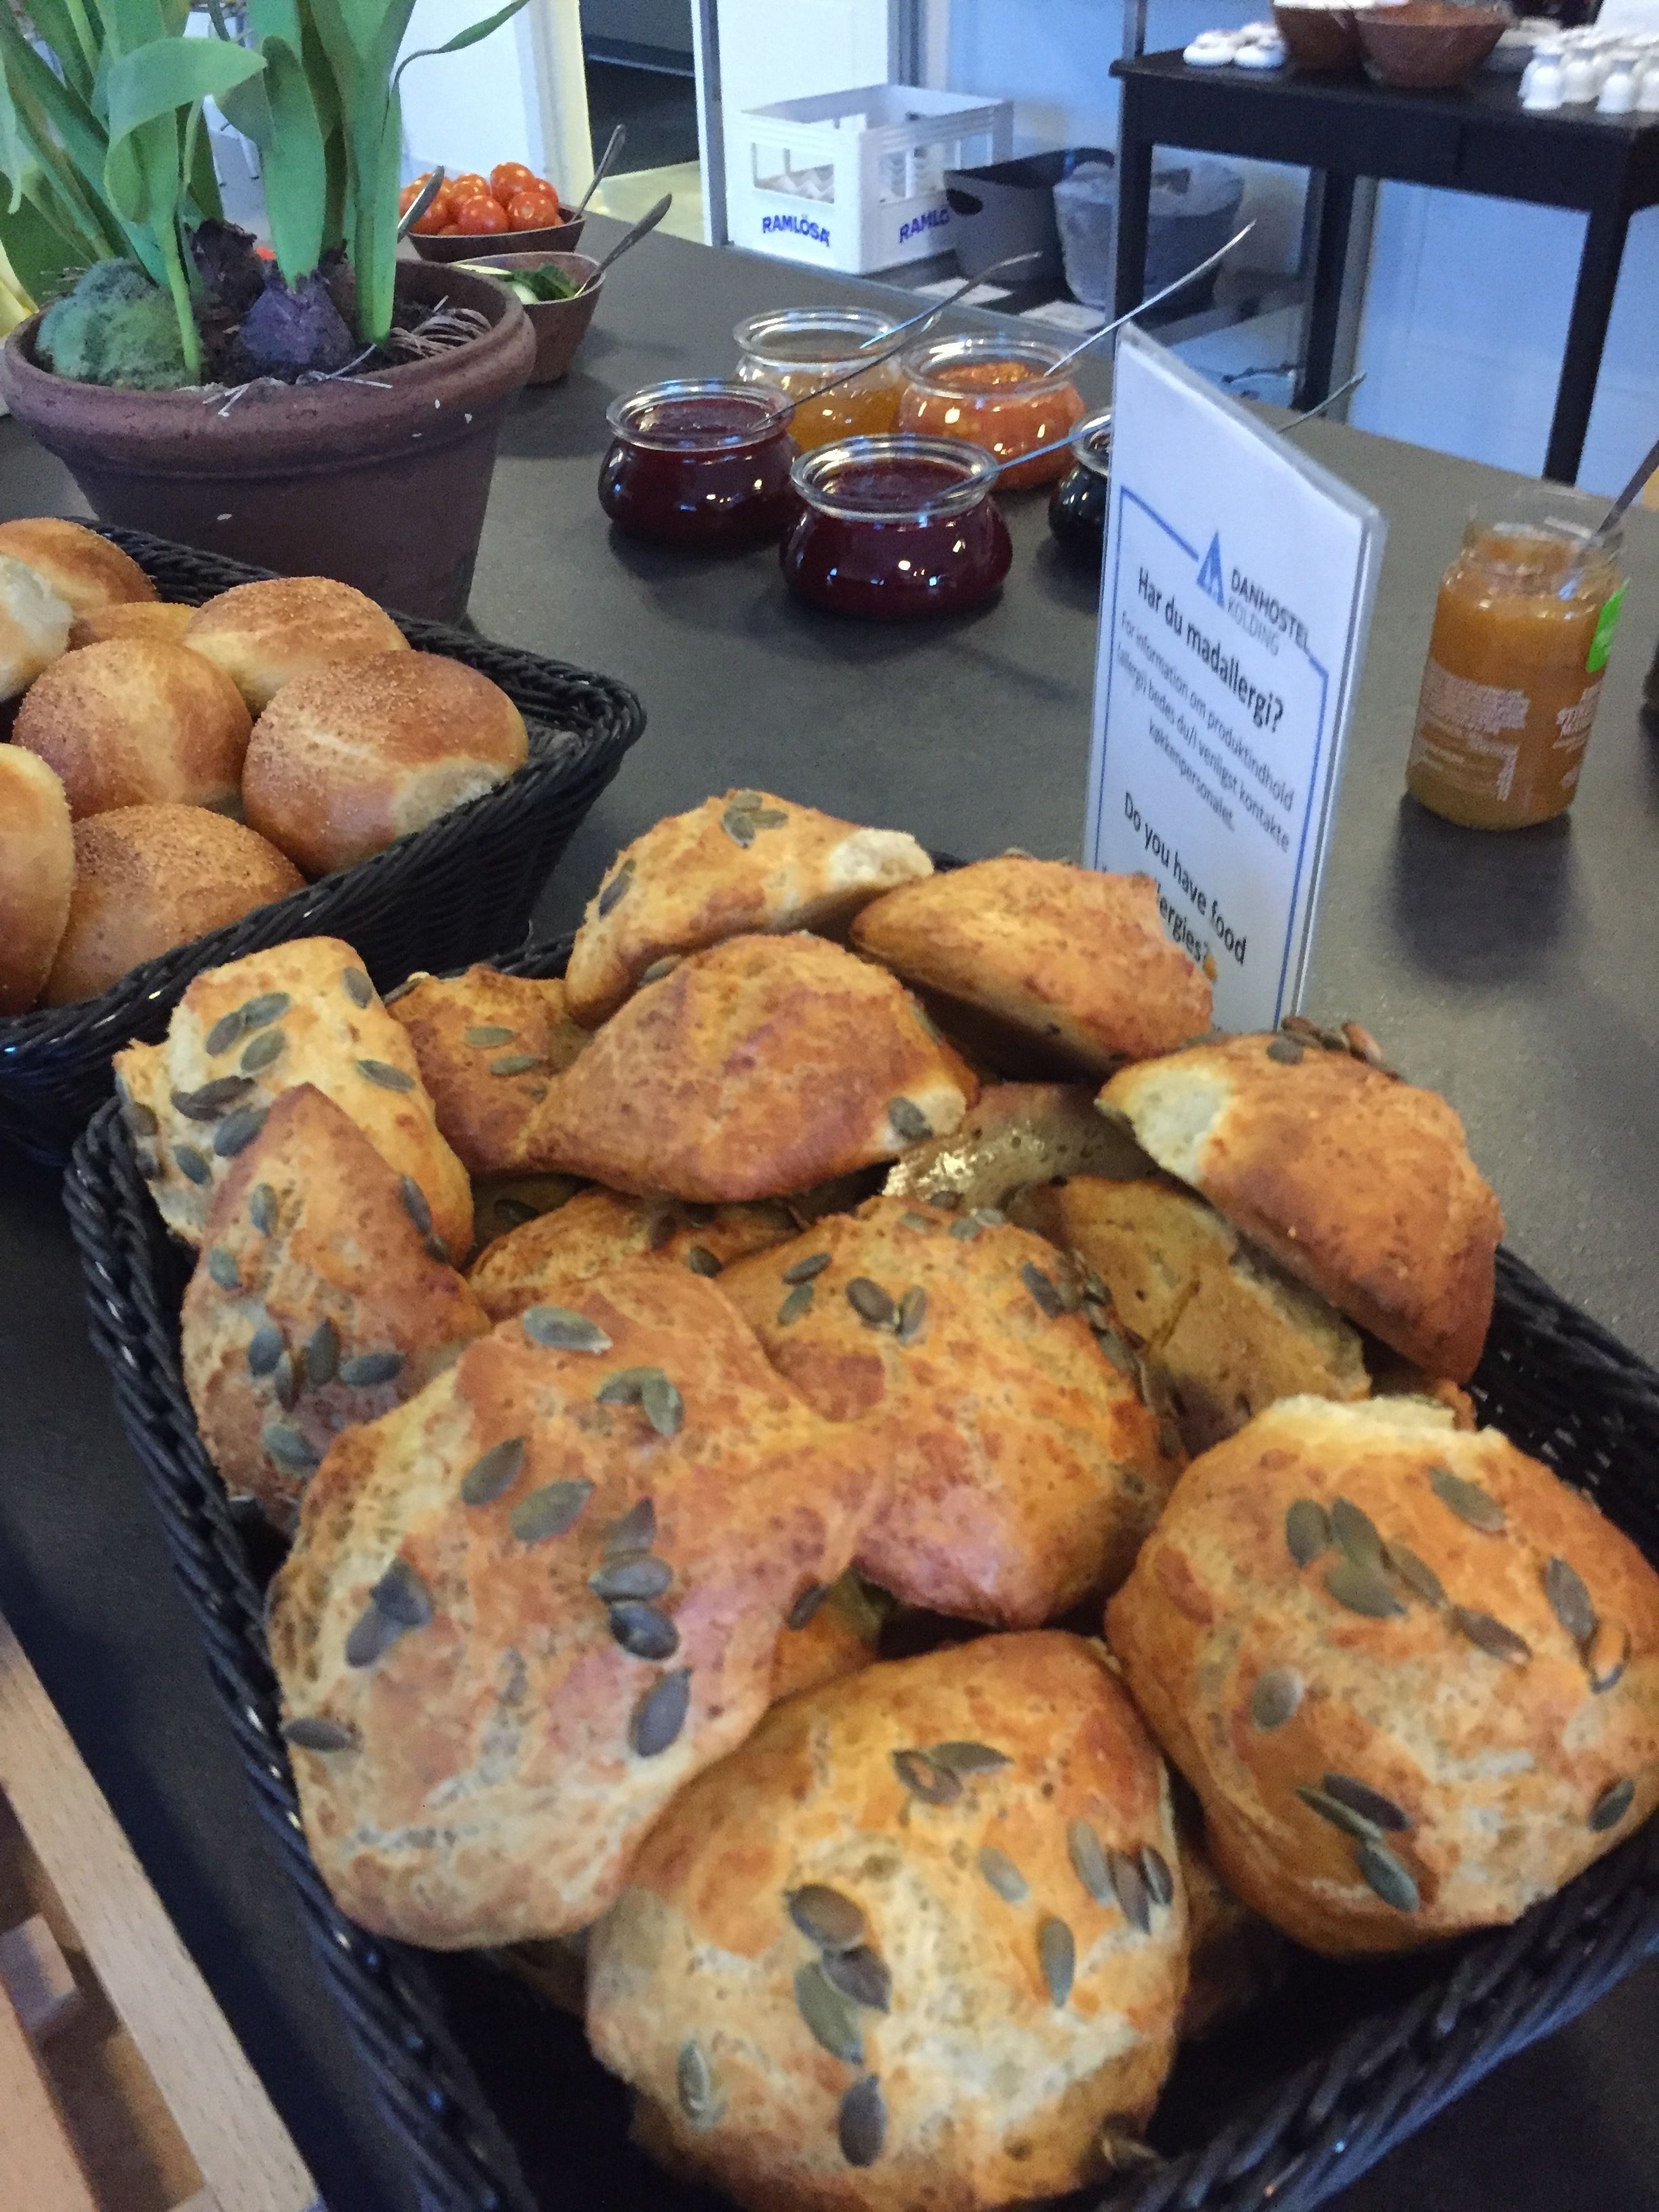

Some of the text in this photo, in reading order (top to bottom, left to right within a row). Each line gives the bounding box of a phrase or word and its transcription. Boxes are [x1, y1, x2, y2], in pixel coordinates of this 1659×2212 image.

[762, 213, 830, 247] RAMLÖSA
[1138, 566, 1284, 733] Har du madallergi?
[1227, 591, 1280, 657] KOLDING
[1231, 567, 1309, 655] DANHOSTEL
[1136, 633, 1189, 698] information
[1190, 691, 1206, 720] om
[1207, 710, 1294, 813] produktindhold
[1240, 782, 1290, 853] kontakte
[1125, 791, 1247, 966] Do you have food
